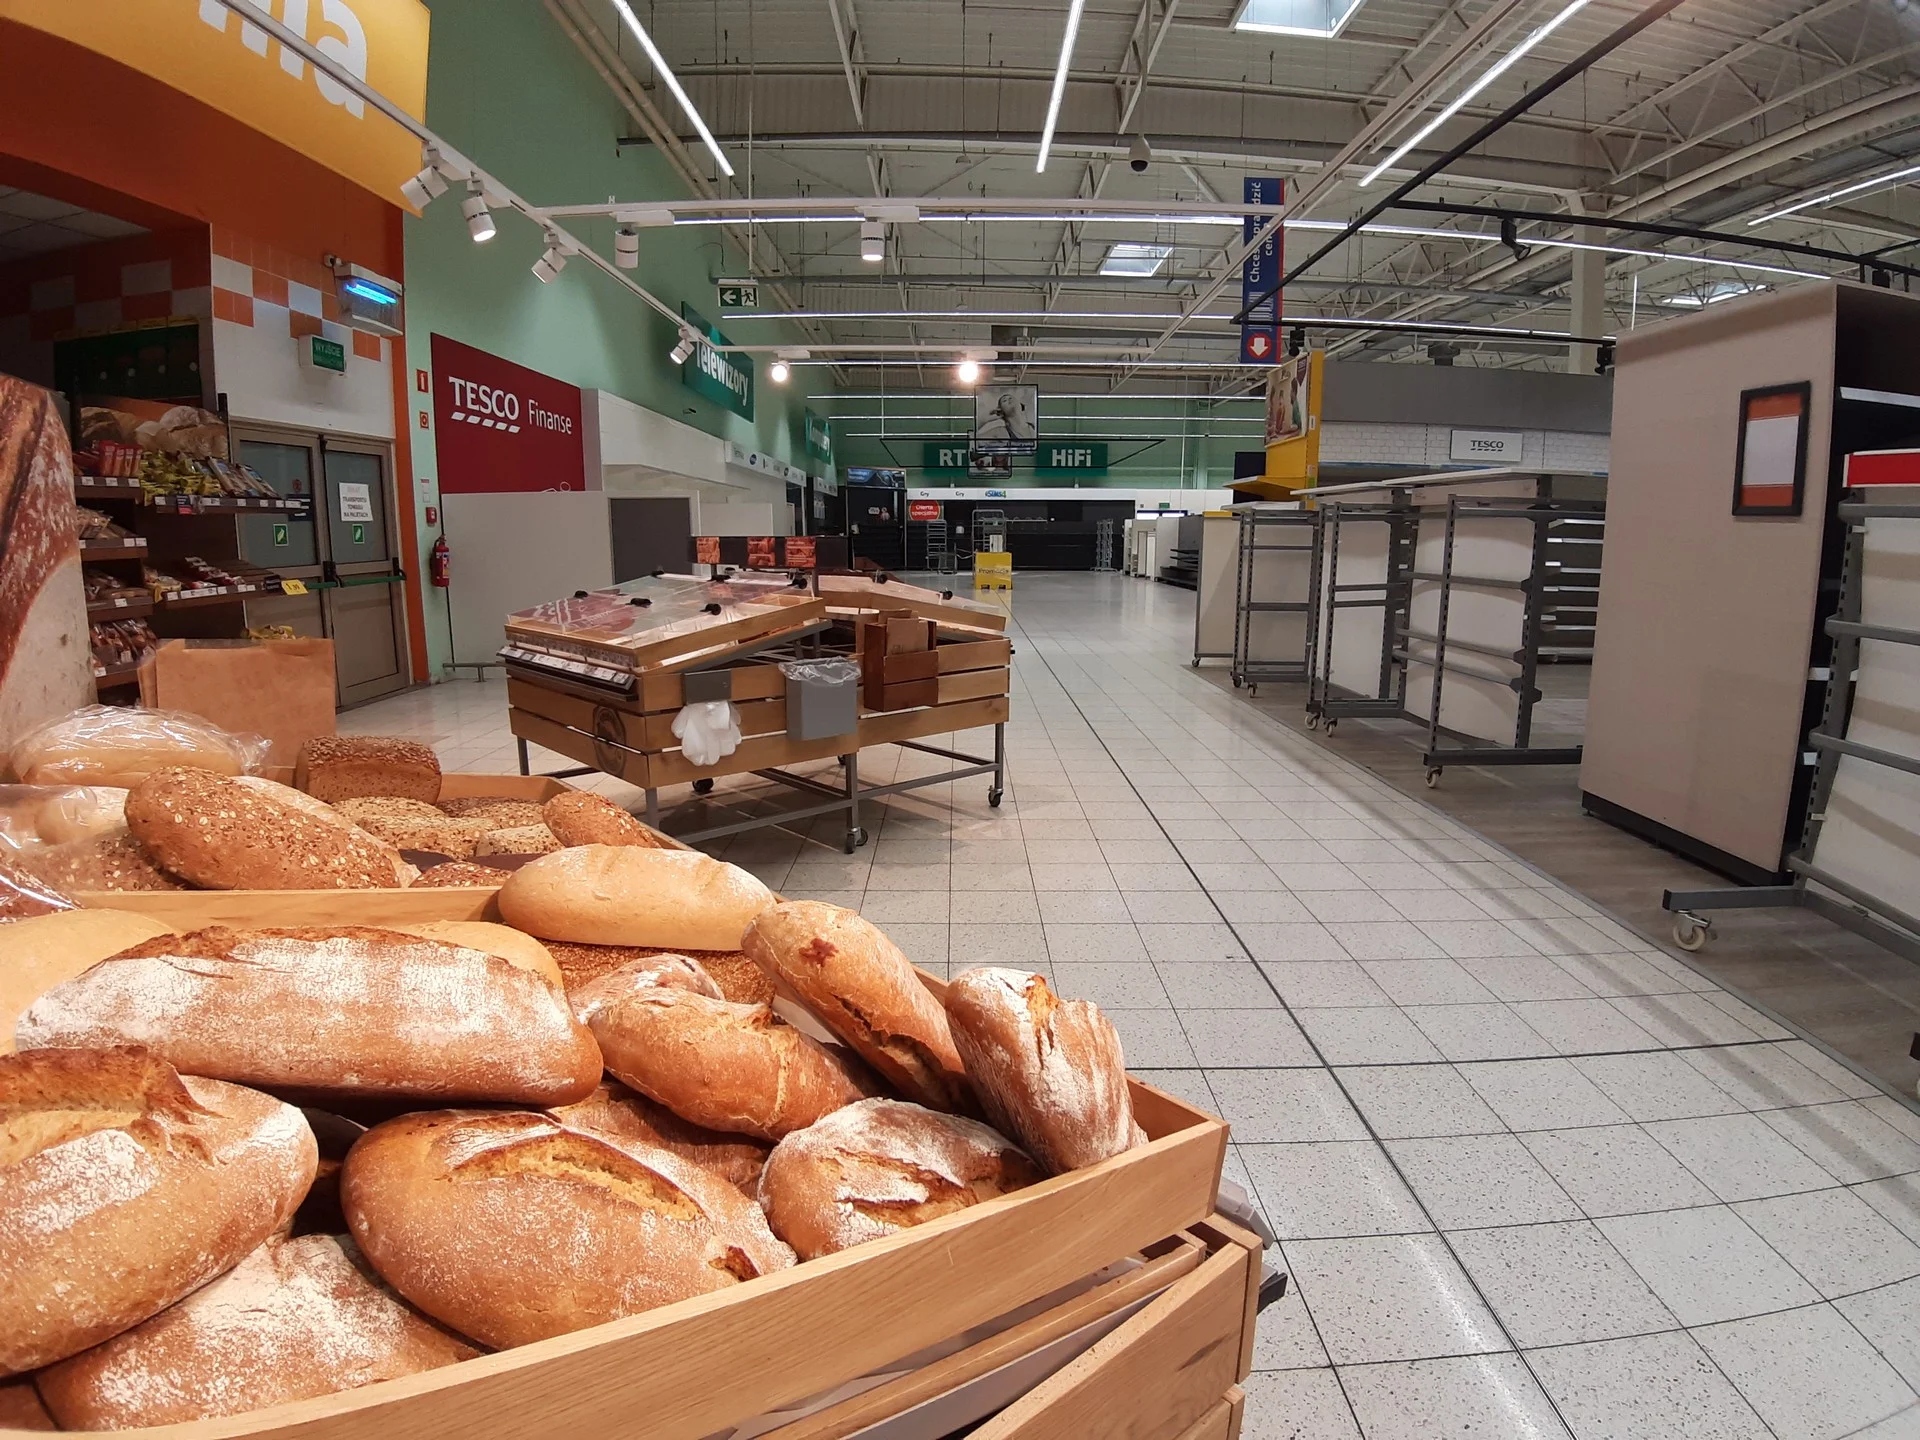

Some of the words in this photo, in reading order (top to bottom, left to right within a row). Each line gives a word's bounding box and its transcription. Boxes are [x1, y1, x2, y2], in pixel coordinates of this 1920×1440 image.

[448, 376, 520, 421] TESCO
[528, 399, 572, 435] Finanse
[1470, 440, 1504, 449] TESCO
[1052, 449, 1091, 467] HiFi
